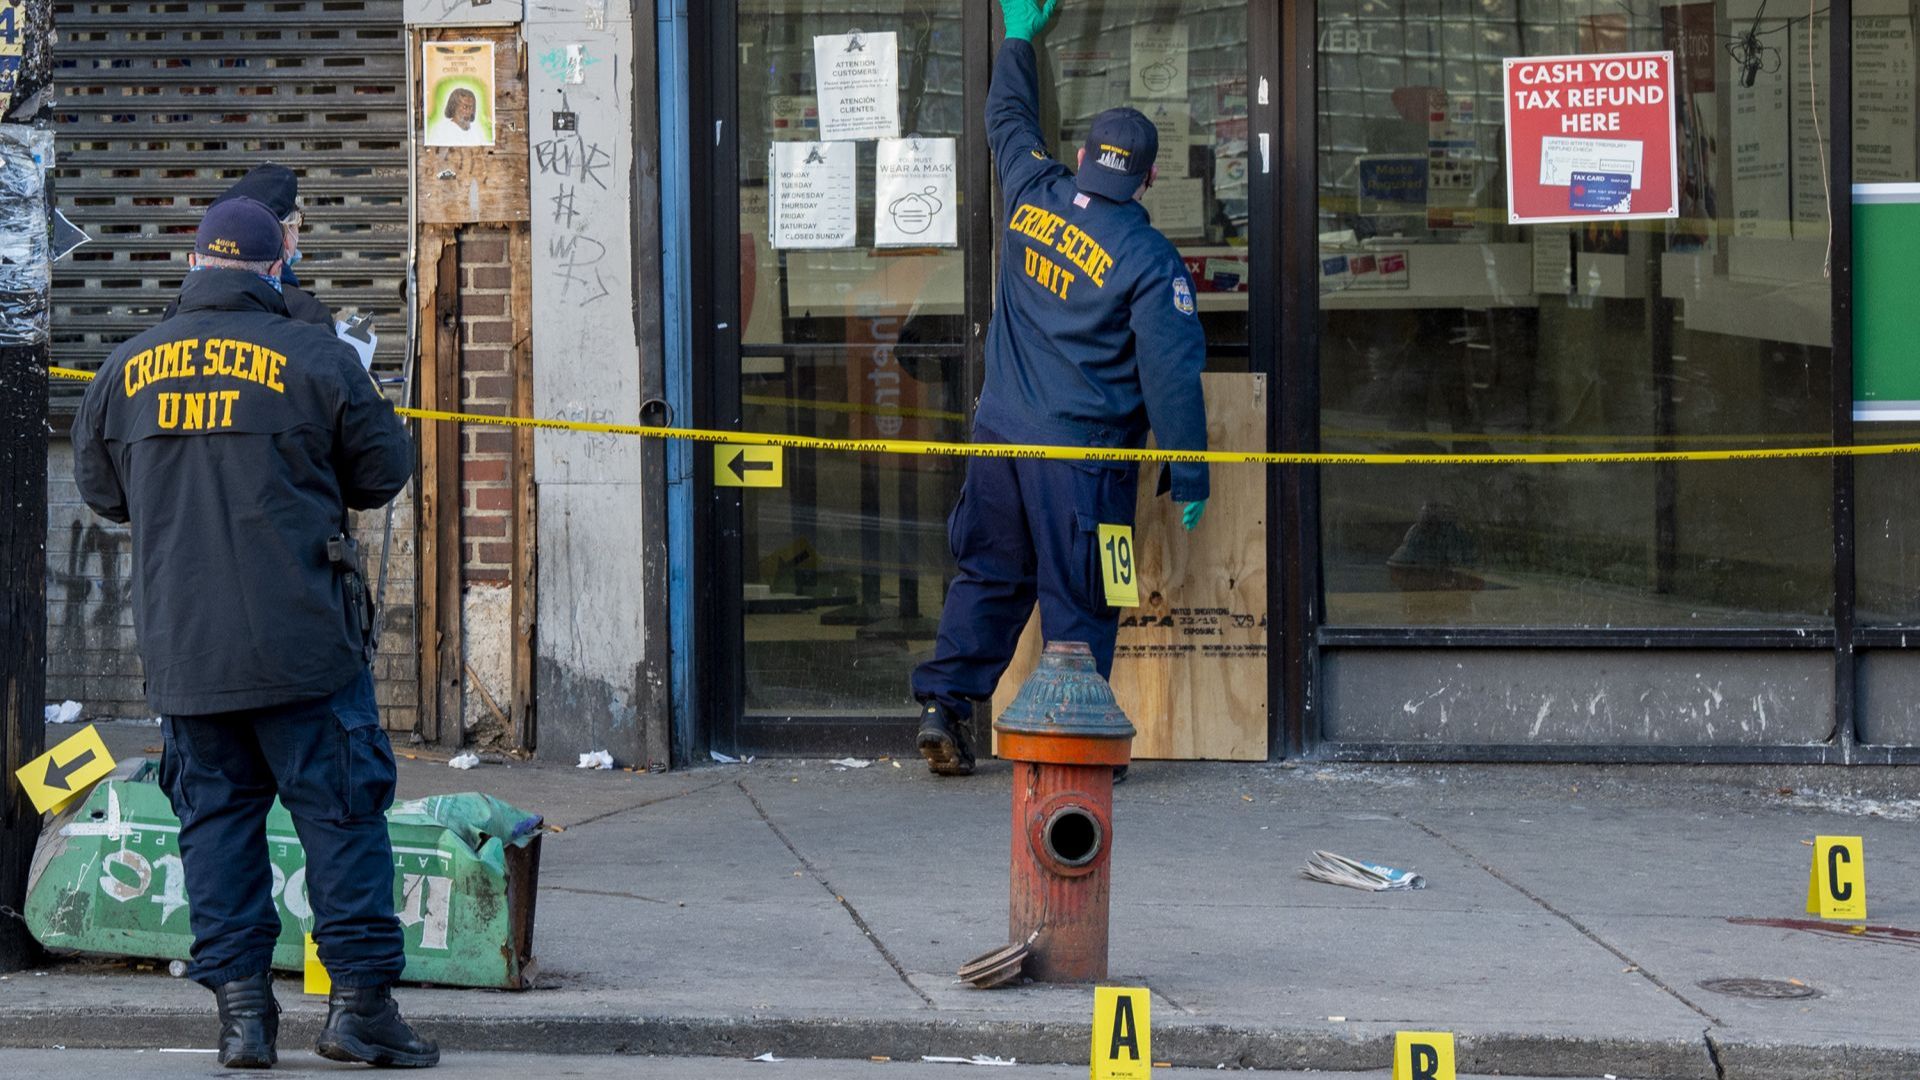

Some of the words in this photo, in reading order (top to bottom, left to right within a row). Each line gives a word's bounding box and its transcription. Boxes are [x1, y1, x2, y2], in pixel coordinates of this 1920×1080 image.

[835, 60, 876, 68] ATTENTION
[1519, 63, 1583, 85] CASH
[1589, 60, 1659, 81] YOUR
[840, 96, 876, 105] ATENCIÓN
[1515, 89, 1561, 110] TAX
[1568, 85, 1664, 108] REFUND
[1561, 112, 1620, 133] HERE
[880, 164, 909, 173] WEAR
[913, 164, 920, 172] A
[923, 164, 953, 173] MASK
[1009, 204, 1066, 247] CRIME
[1056, 224, 1114, 288] SCENE
[1025, 246, 1075, 300] UNIT
[124, 338, 199, 398] CRIME
[203, 338, 287, 393] SCENE
[158, 390, 240, 430] UNIT
[1106, 535, 1132, 585] 19
[1120, 616, 1174, 627] APA
[1828, 845, 1852, 901] C
[1109, 995, 1140, 1060] A
[1410, 1043, 1438, 1080] B
